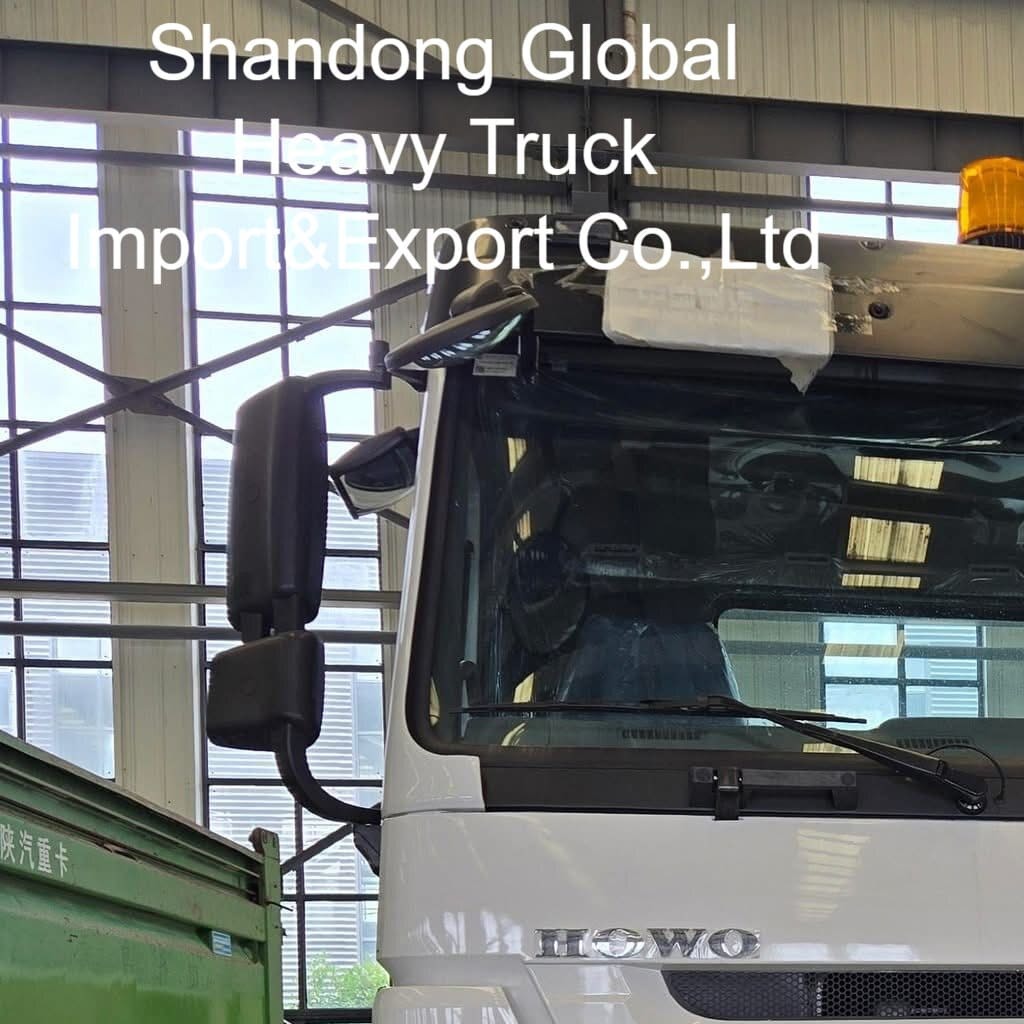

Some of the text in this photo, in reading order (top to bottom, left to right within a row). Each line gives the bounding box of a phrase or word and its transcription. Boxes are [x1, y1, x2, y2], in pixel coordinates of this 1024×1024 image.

[0, 823, 69, 878] 陕汽重卡
[534, 928, 760, 959] HOWO
